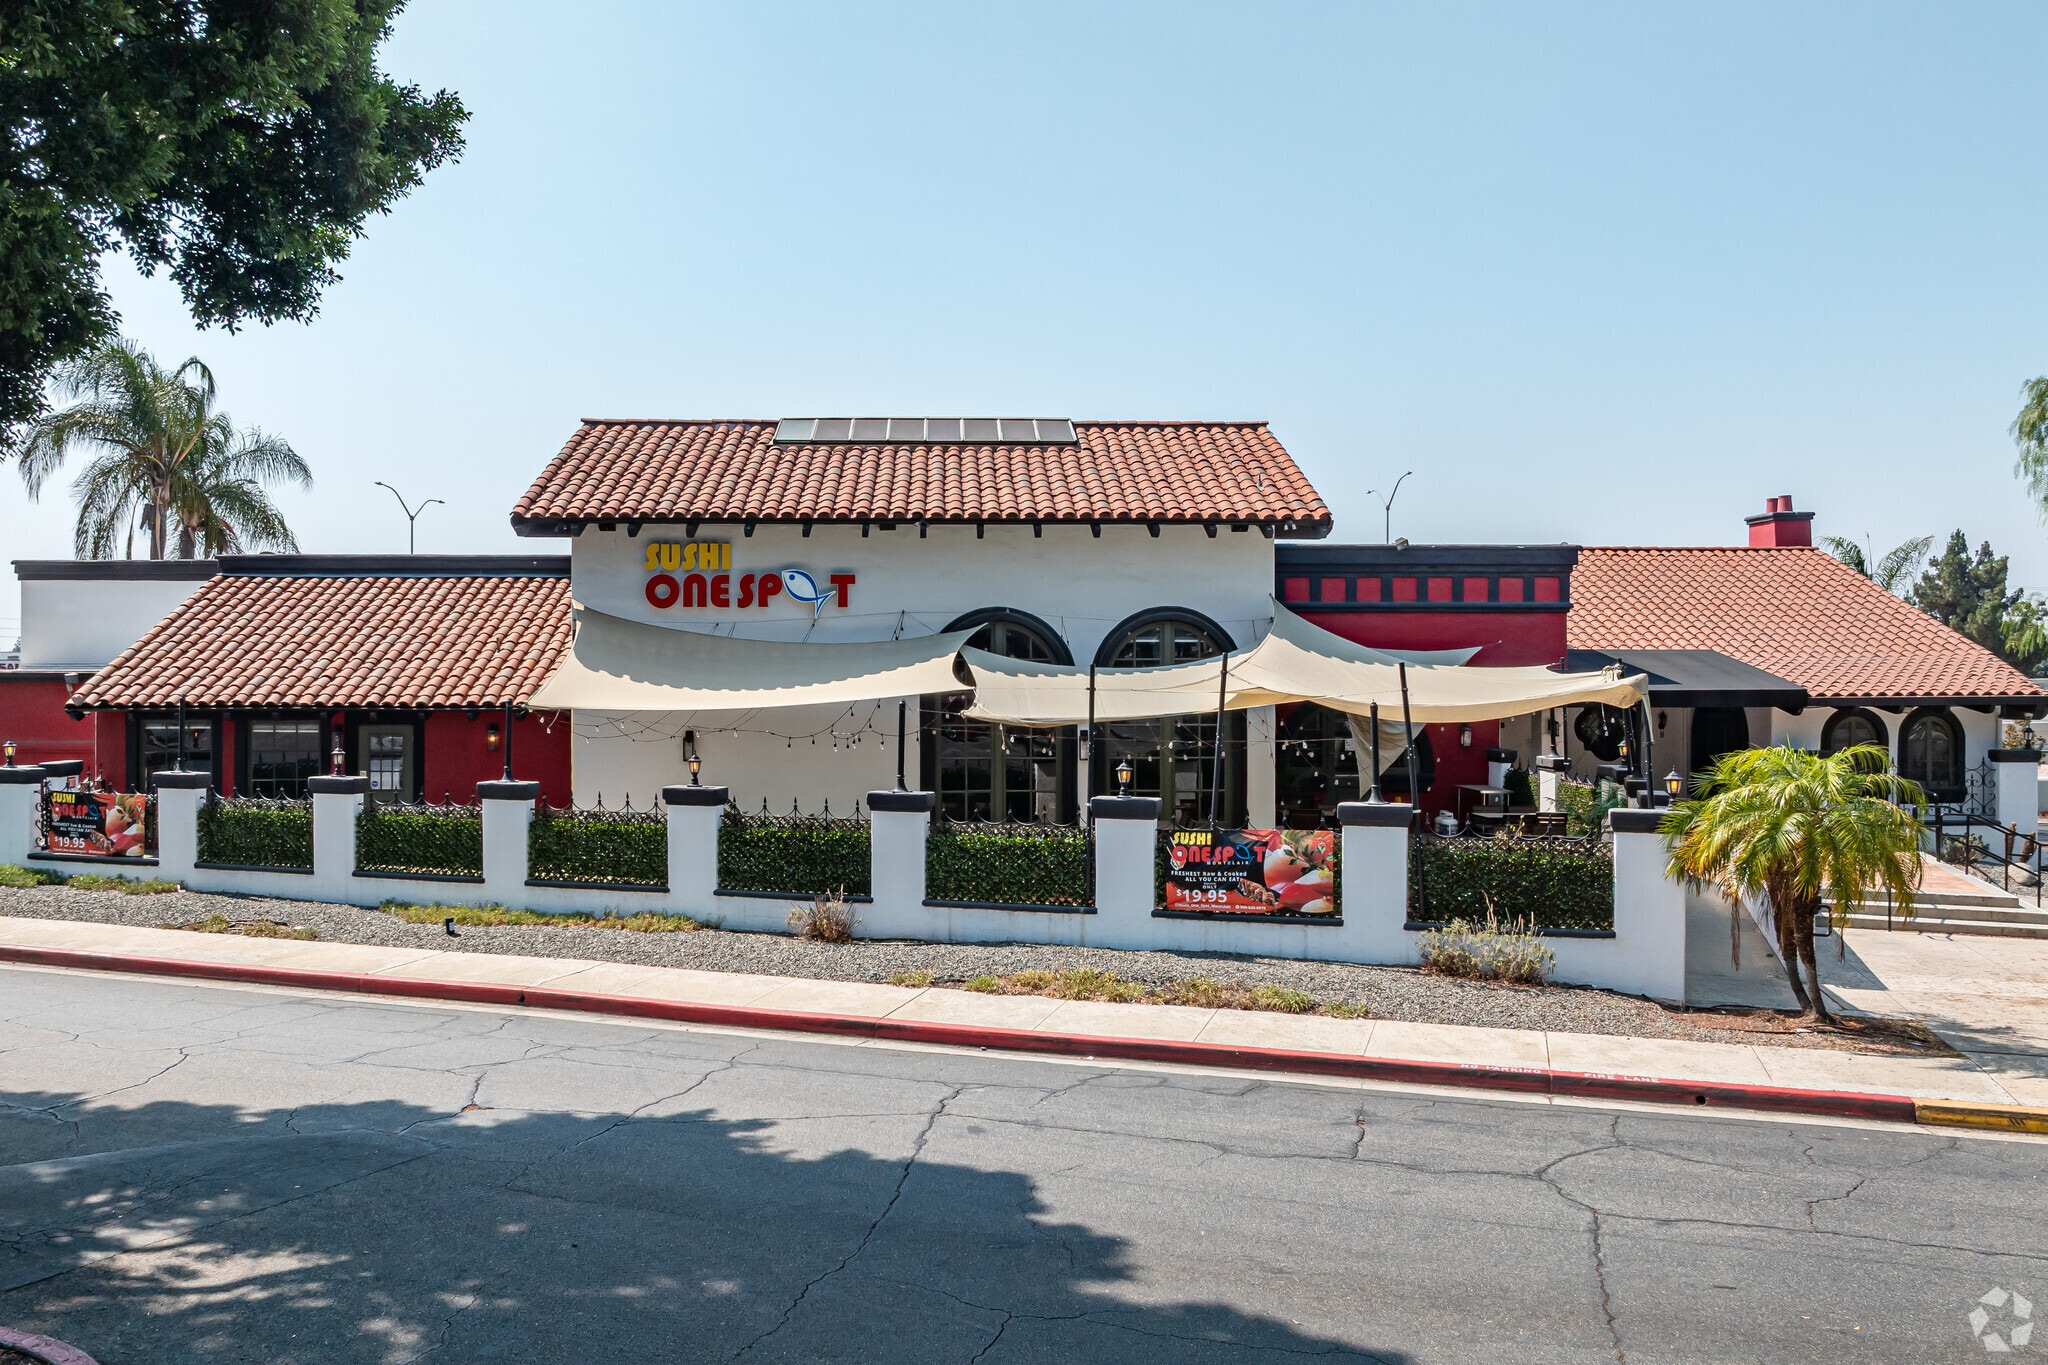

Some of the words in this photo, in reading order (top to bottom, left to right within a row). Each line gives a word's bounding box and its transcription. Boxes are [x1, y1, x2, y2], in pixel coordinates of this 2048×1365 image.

[645, 543, 731, 571] SUSHI
[645, 573, 730, 609] ONE
[52, 792, 76, 804] SUSHI
[55, 837, 86, 848] $19.95
[1174, 832, 1212, 845] SUSHI
[1172, 846, 1211, 862] ONE
[1176, 889, 1228, 903] $19.95
[1486, 1065, 1542, 1074] PARKING
